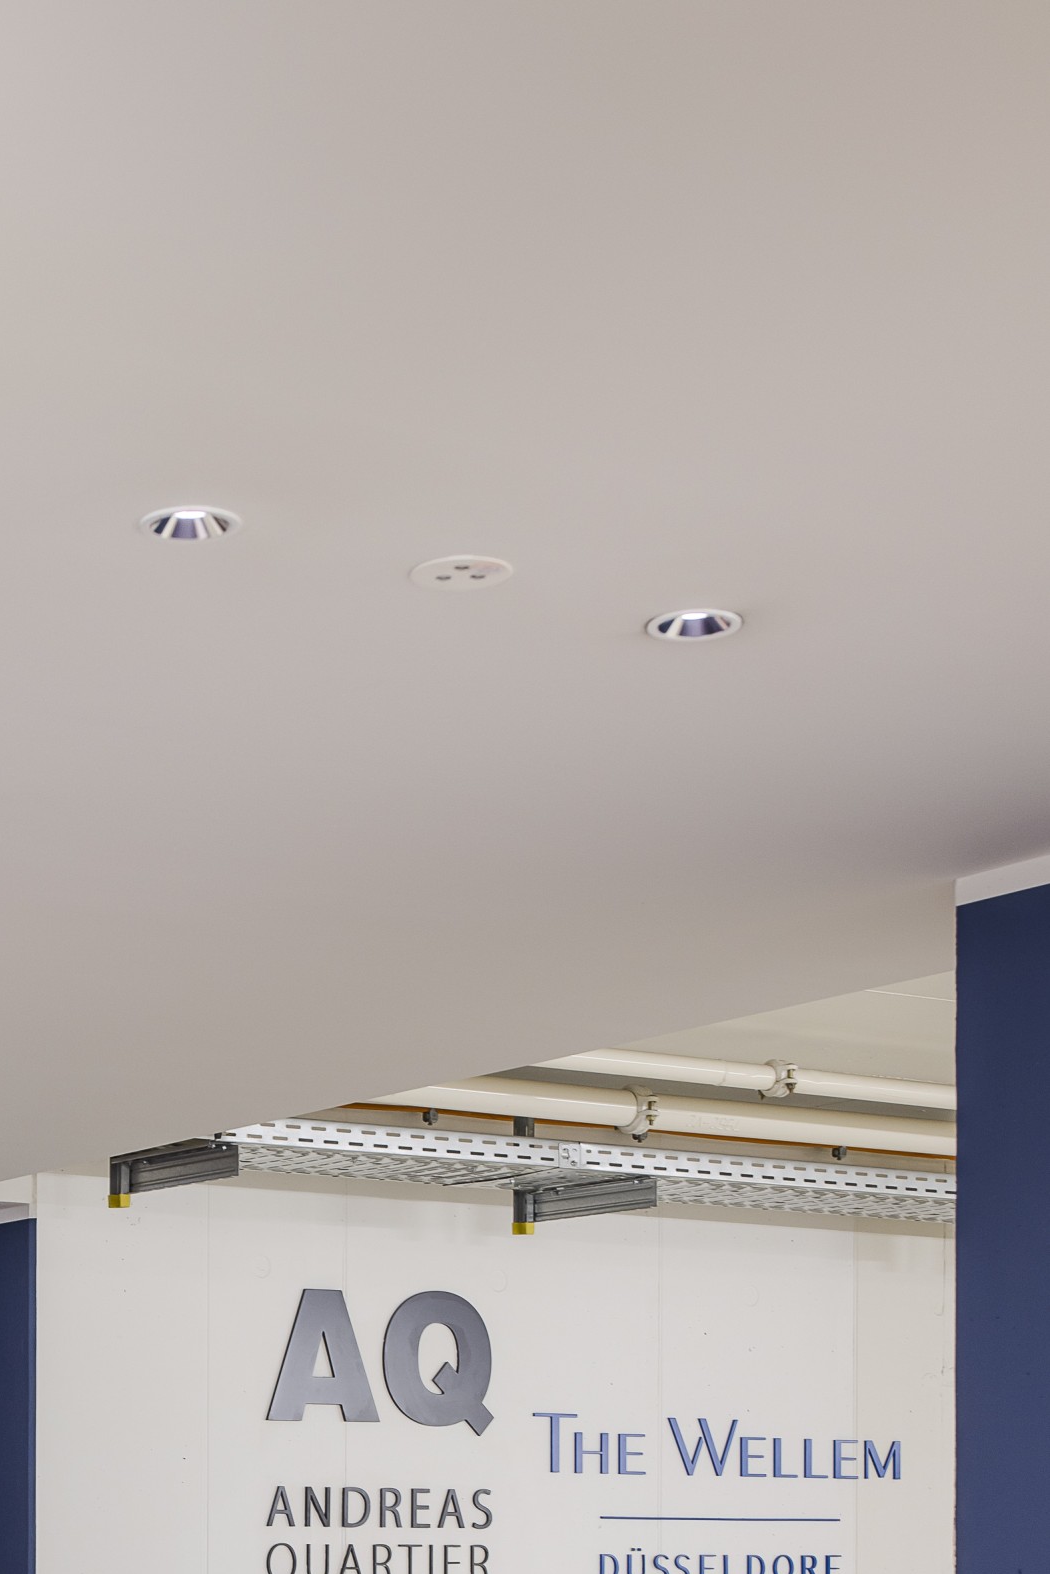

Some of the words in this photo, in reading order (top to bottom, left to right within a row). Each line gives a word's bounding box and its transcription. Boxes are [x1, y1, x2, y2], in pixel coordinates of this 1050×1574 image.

[265, 1289, 494, 1436] AQ
[532, 1413, 646, 1475] THE
[667, 1418, 901, 1480] WELLEM
[266, 1486, 492, 1529] ANDREAS
